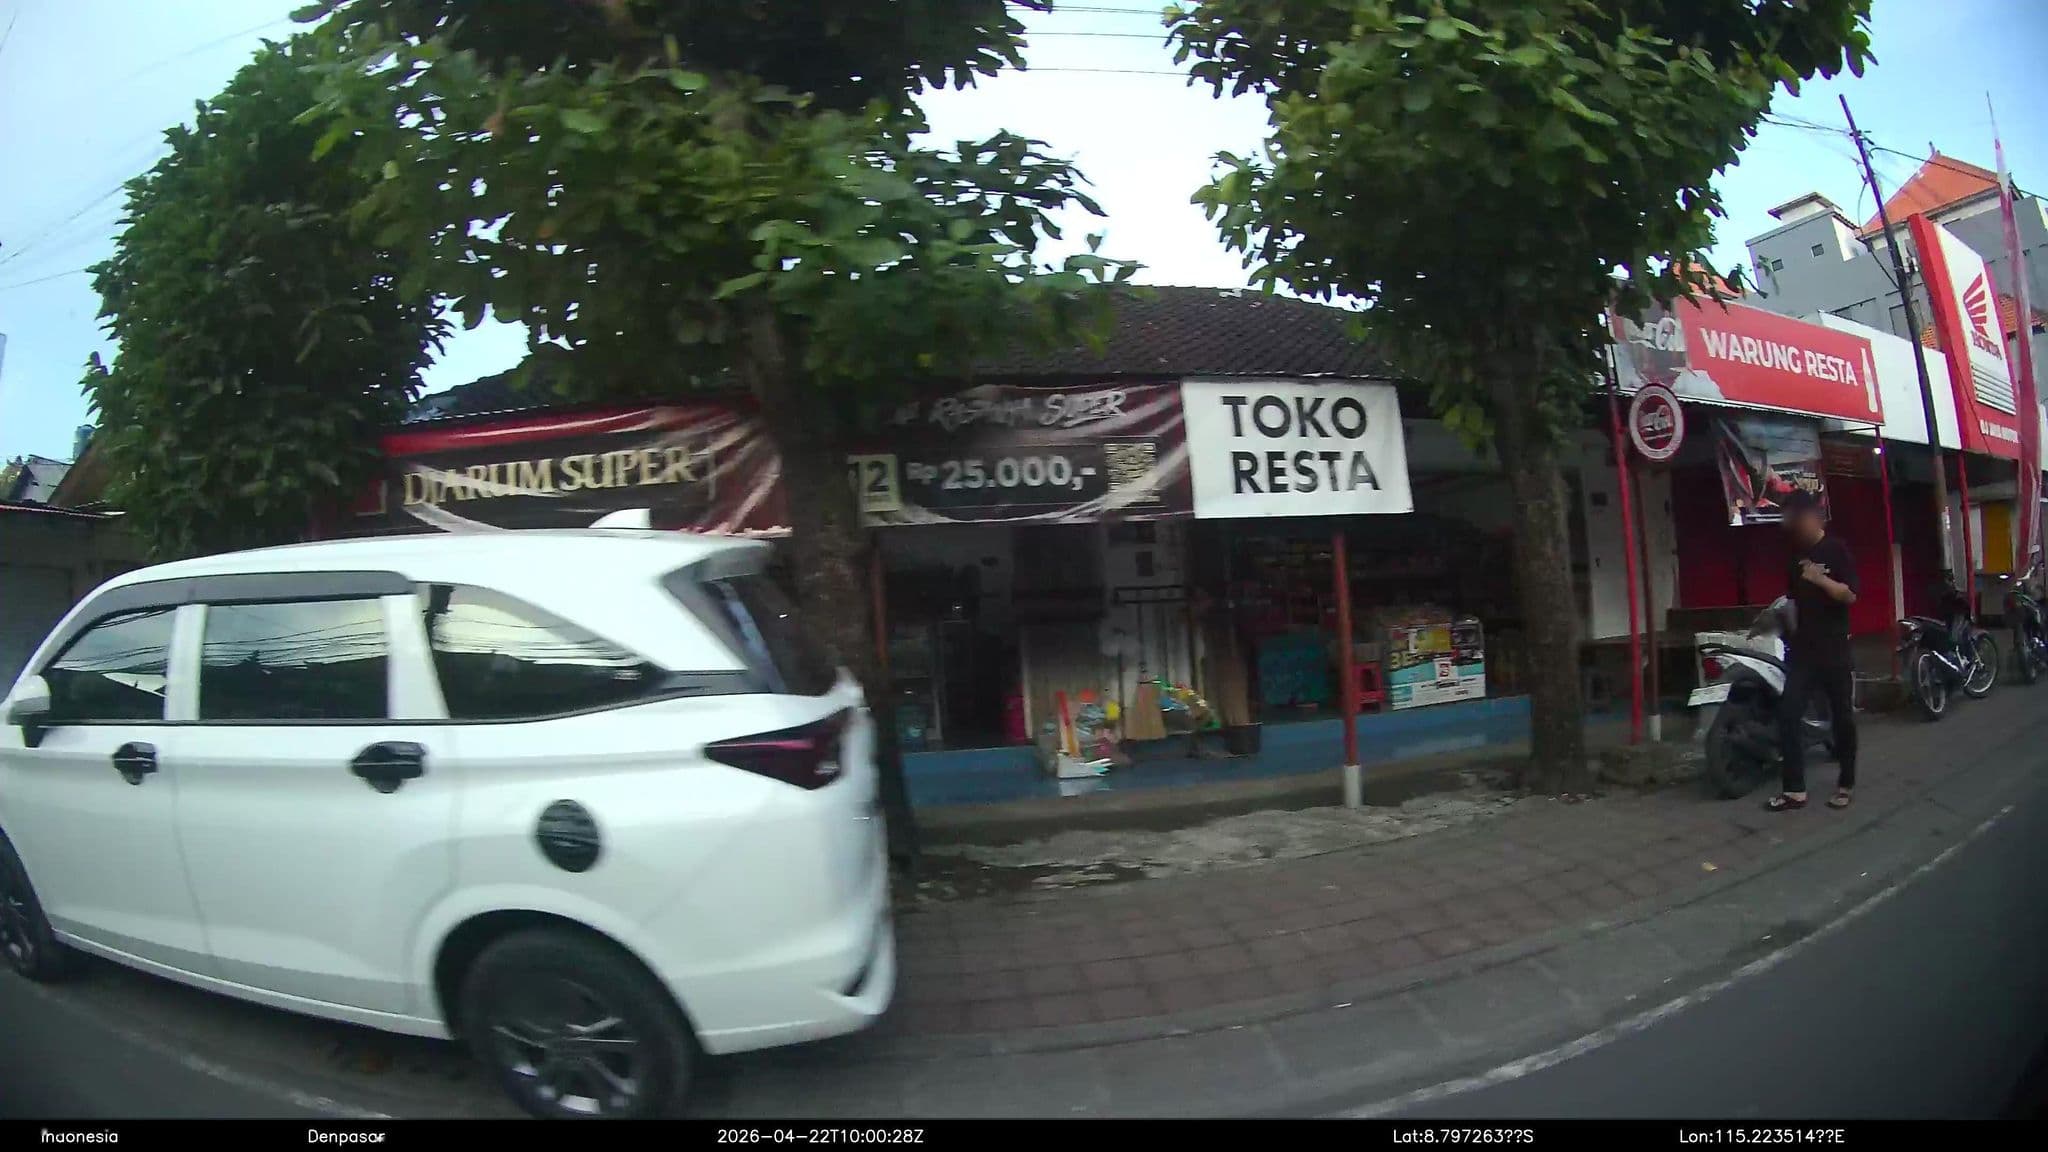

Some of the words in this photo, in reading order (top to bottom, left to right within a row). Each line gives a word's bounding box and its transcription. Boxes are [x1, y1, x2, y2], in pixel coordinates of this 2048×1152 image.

[1701, 328, 1802, 373] WARUNG
[1806, 350, 1858, 386] RESTA
[1222, 395, 1367, 438] TOKO
[560, 447, 695, 491] SUPER
[1232, 450, 1381, 495] RESTA
